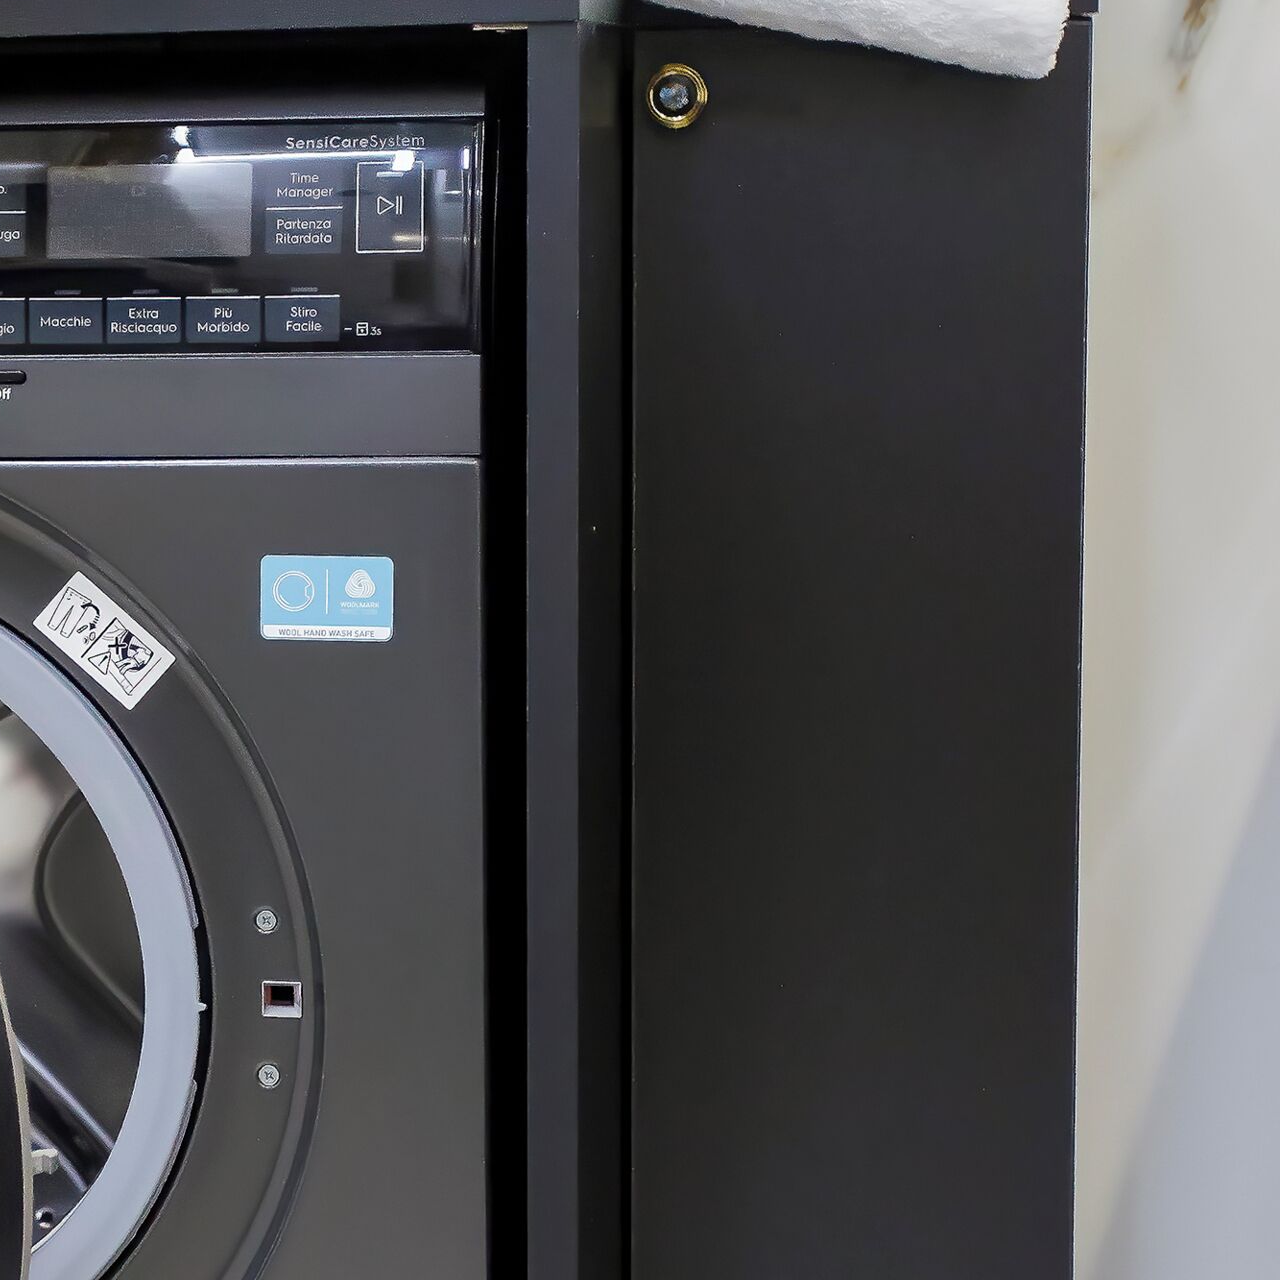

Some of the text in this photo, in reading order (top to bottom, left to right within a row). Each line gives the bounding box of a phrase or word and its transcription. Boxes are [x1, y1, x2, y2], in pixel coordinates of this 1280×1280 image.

[285, 134, 425, 149] SensiCareSystem
[290, 172, 319, 184] Time
[276, 186, 333, 200] Manager
[276, 218, 332, 230] Partenza
[128, 308, 159, 319] Extra
[290, 306, 317, 318] Stiro
[40, 315, 92, 328] Macchie
[197, 321, 250, 333] Morbido
[286, 321, 322, 332] Facile
[111, 322, 177, 335] Risciacquo
[370, 326, 382, 336] 3s
[304, 629, 327, 637] HAND
[329, 629, 353, 637] WASH
[354, 630, 375, 638] SAFE
